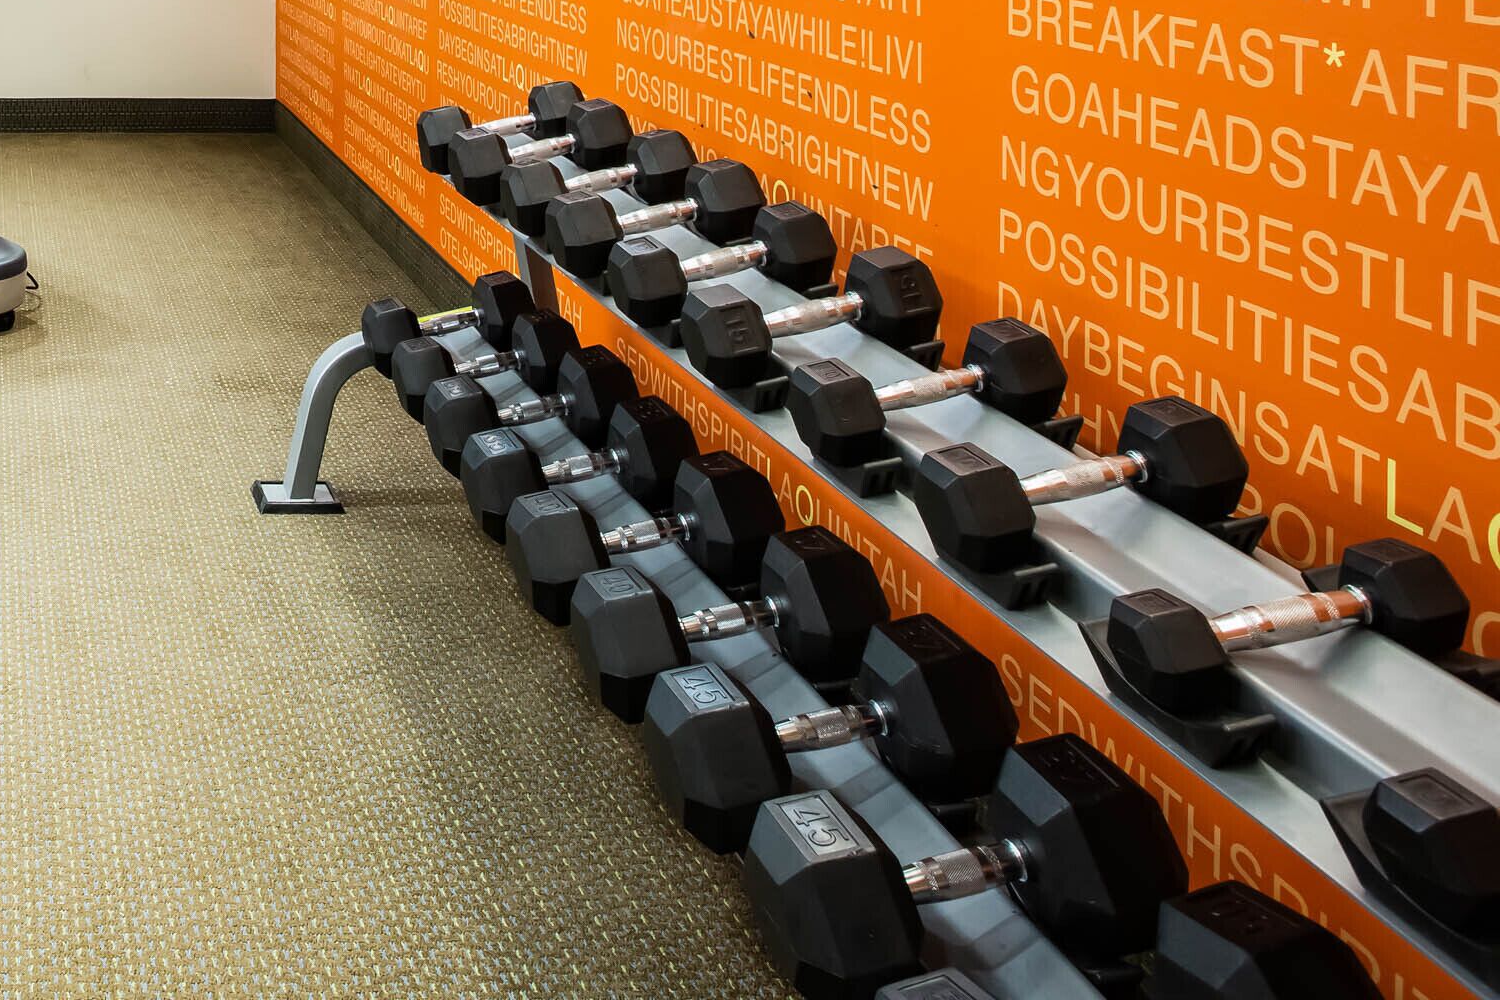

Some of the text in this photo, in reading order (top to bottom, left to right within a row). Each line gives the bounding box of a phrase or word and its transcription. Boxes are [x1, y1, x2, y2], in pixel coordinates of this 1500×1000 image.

[616, 60, 933, 222] POSSIBILITIESABRIGHTNEW
[617, 16, 929, 154] NGYOURBESTLIFEENDLESS
[1011, 61, 1499, 242] GOAHEADSTAYA
[1000, 204, 1500, 460] POSSIBILITIESAB
[601, 571, 635, 594] 40
[681, 675, 727, 705] 45
[793, 805, 850, 848] 45
